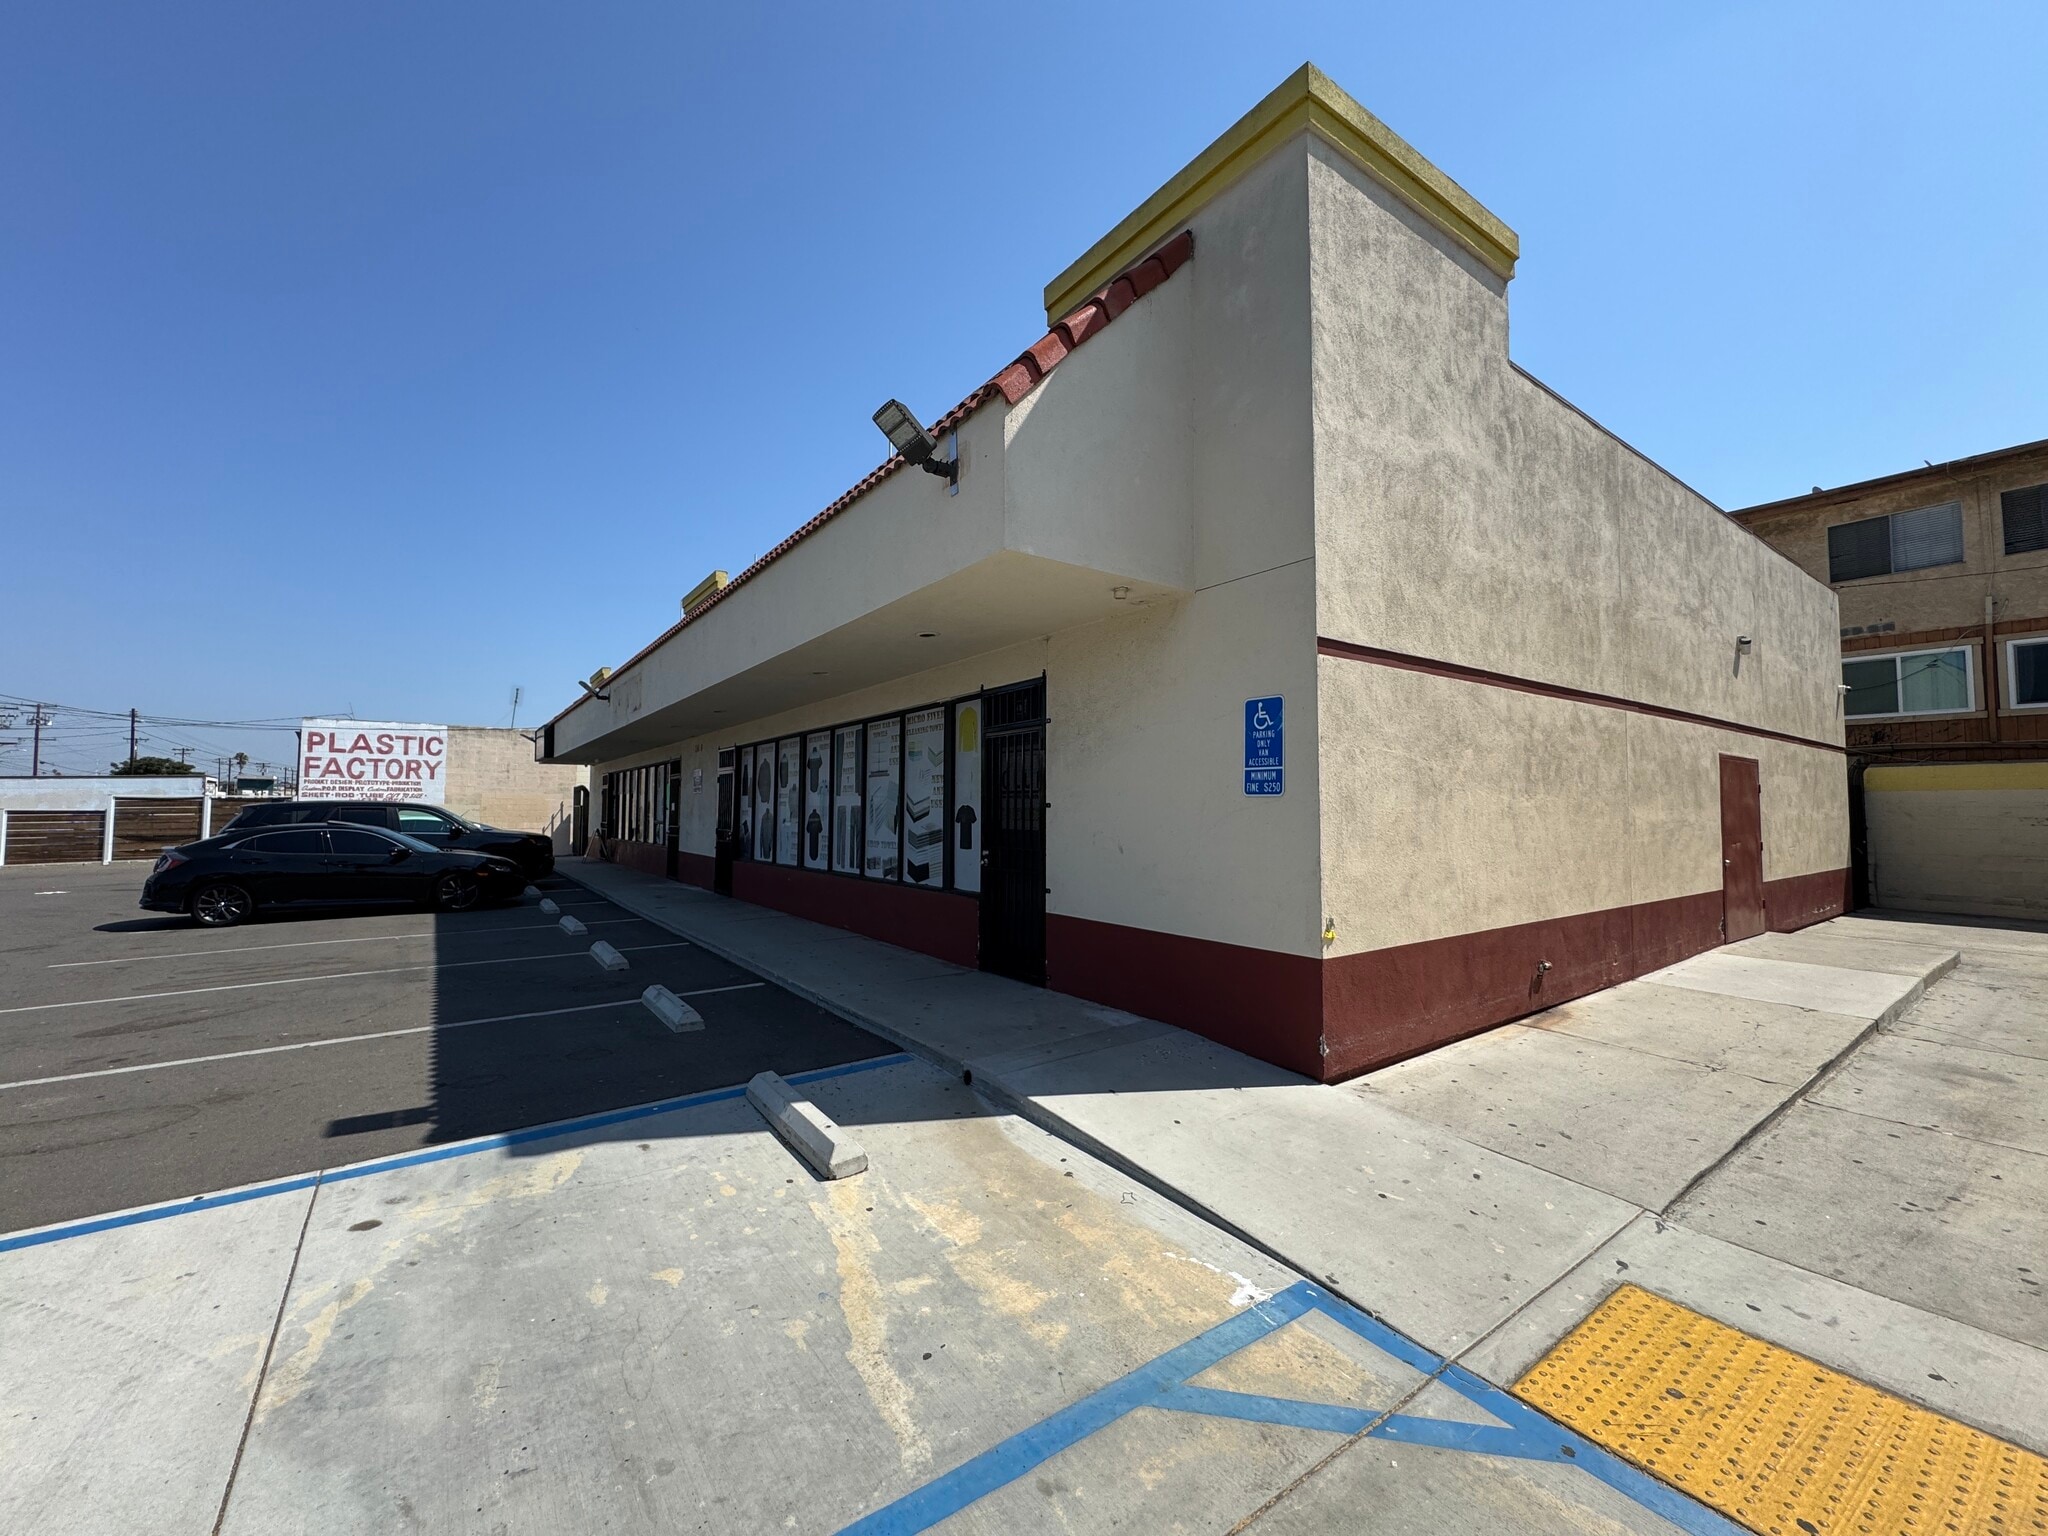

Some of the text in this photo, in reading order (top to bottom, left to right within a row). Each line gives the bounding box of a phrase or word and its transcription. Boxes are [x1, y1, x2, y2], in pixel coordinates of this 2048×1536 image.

[907, 713, 926, 724] MICRO
[1252, 730, 1275, 739] PARKING
[307, 731, 444, 756] PLASTIC
[1256, 739, 1271, 748] ONLY
[1248, 757, 1279, 766] ACCESSIBLE
[304, 757, 443, 780] FACTORY
[1250, 770, 1277, 781] MINIMUM
[1246, 782, 1259, 792] FINE
